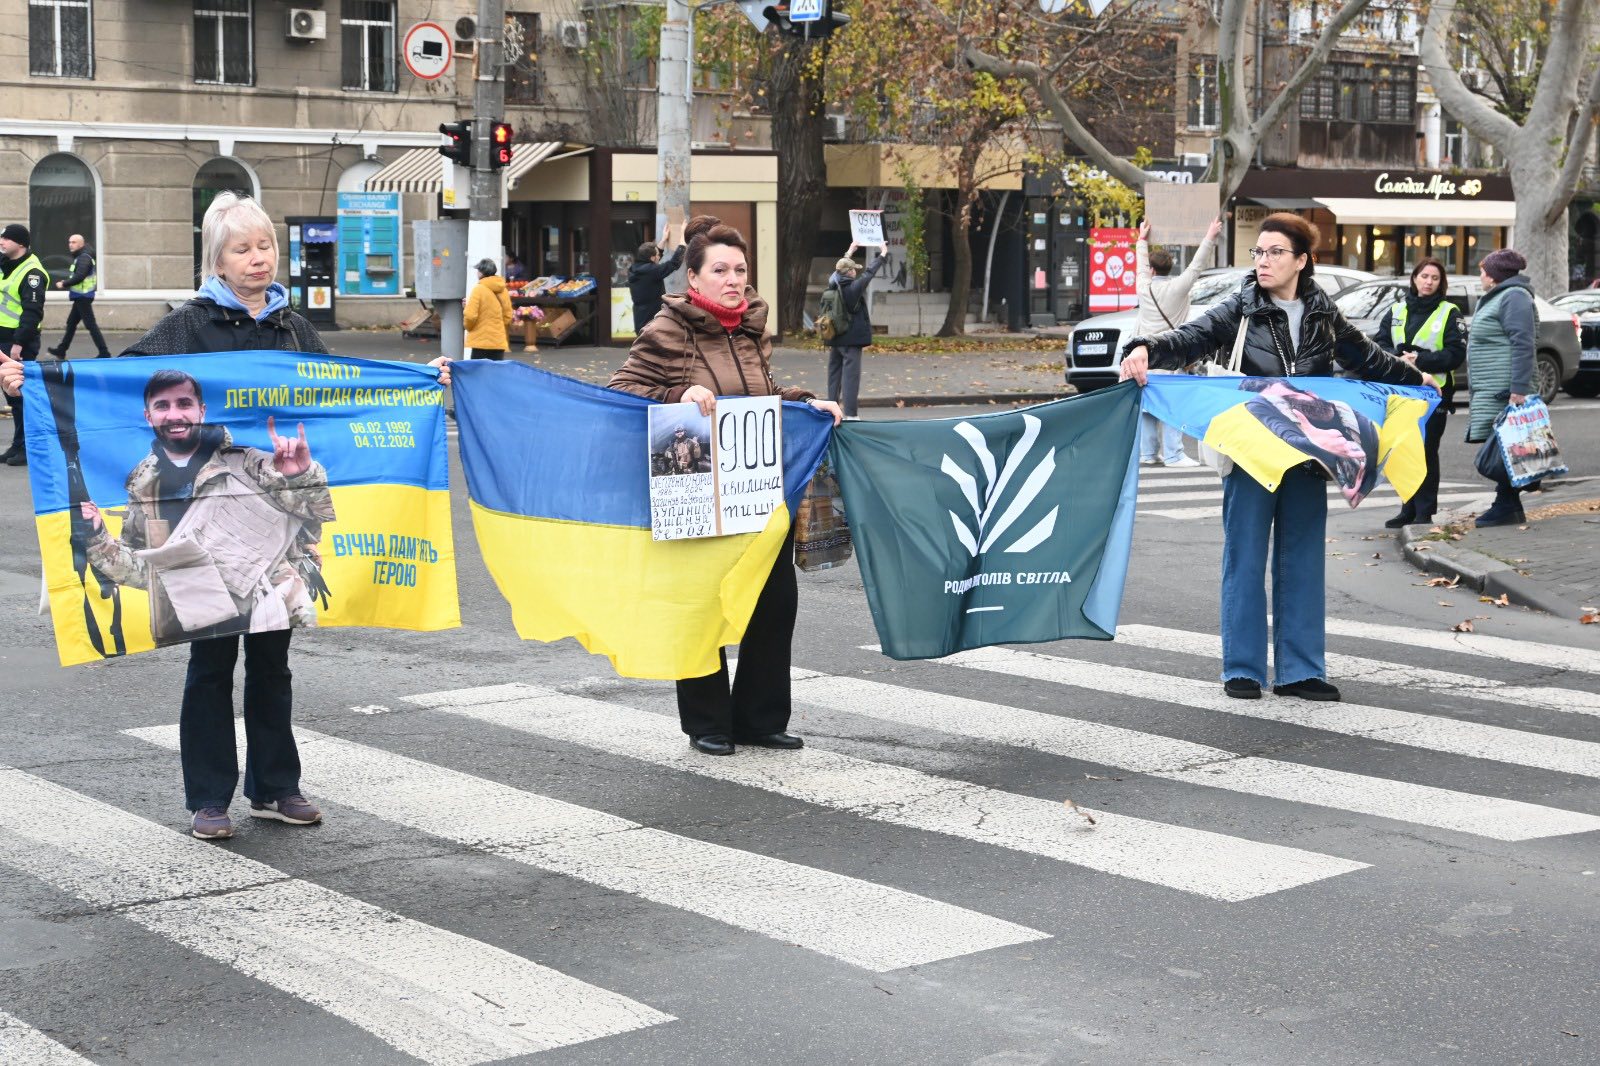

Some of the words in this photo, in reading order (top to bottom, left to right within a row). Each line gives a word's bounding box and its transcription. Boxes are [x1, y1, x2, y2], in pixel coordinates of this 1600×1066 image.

[500, 149, 509, 162] 6
[224, 384, 290, 409] ЛЕГКИЙ
[293, 387, 352, 408] БОГДАН
[354, 386, 445, 408] ВАЛЕРІЙОВИ
[349, 421, 413, 435] 06.02.1992
[354, 434, 416, 449] 04.12.2024
[720, 475, 781, 497] хвилина
[332, 533, 386, 557] ВІЧНА
[373, 560, 417, 588] ГЕРОЮ
[1016, 571, 1072, 585] СВІТЛА
